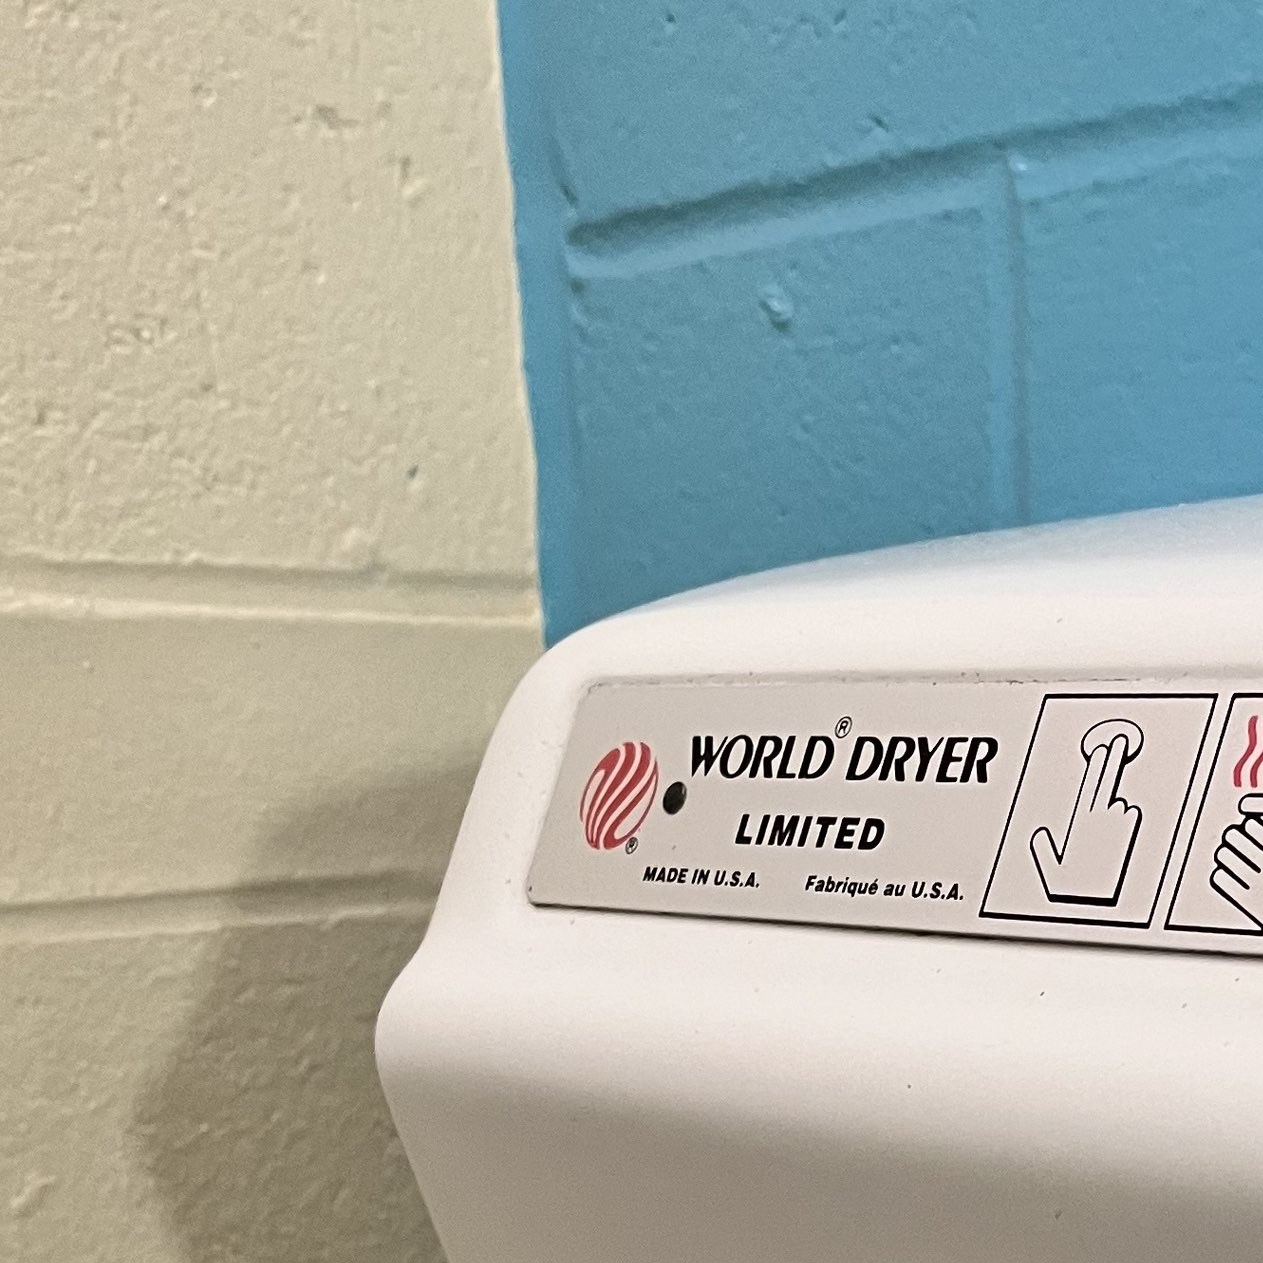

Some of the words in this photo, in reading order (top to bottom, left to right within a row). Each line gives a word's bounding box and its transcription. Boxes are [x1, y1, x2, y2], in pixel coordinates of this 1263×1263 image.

[846, 737, 998, 783] DRYER
[735, 814, 885, 850] LIMITED
[643, 867, 688, 884] MADE
[691, 869, 710, 885] IN
[714, 871, 760, 888] U.S.A.
[805, 875, 878, 897] Fabriqué
[884, 884, 905, 897] au
[911, 881, 964, 900] U.S.A.
